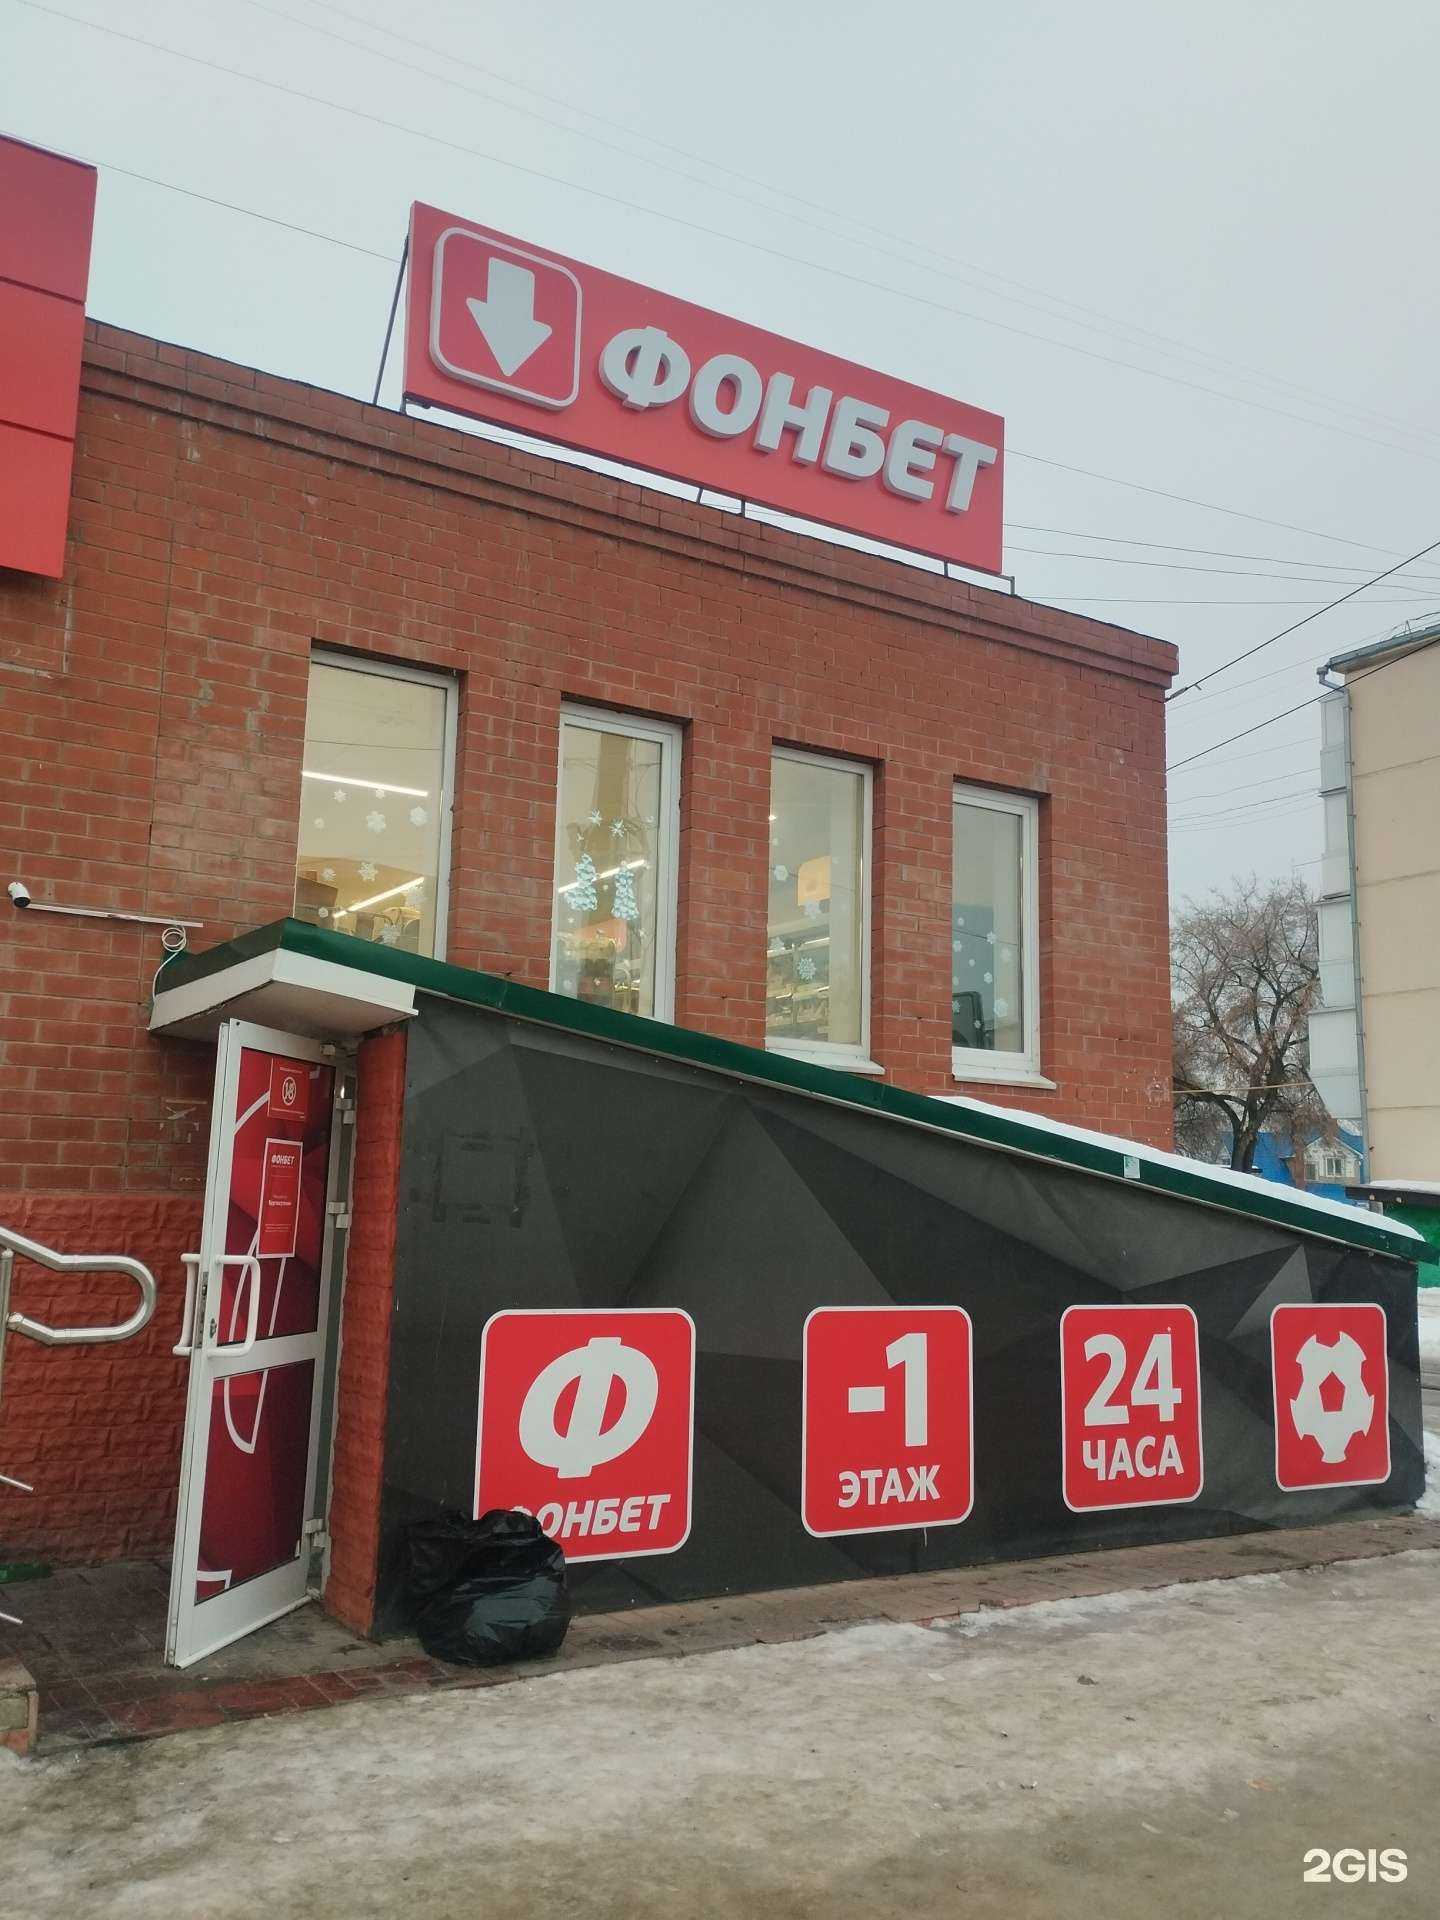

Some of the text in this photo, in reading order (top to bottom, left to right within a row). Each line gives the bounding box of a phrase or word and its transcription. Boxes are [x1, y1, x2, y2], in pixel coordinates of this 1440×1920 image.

[599, 326, 998, 514] ФОНБЕТ
[518, 1336, 658, 1479] Ф
[847, 1332, 928, 1447] -1
[1083, 1333, 1182, 1427] 24
[838, 1465, 940, 1508] ЭТАЖ
[1082, 1434, 1185, 1481] ЧАСА
